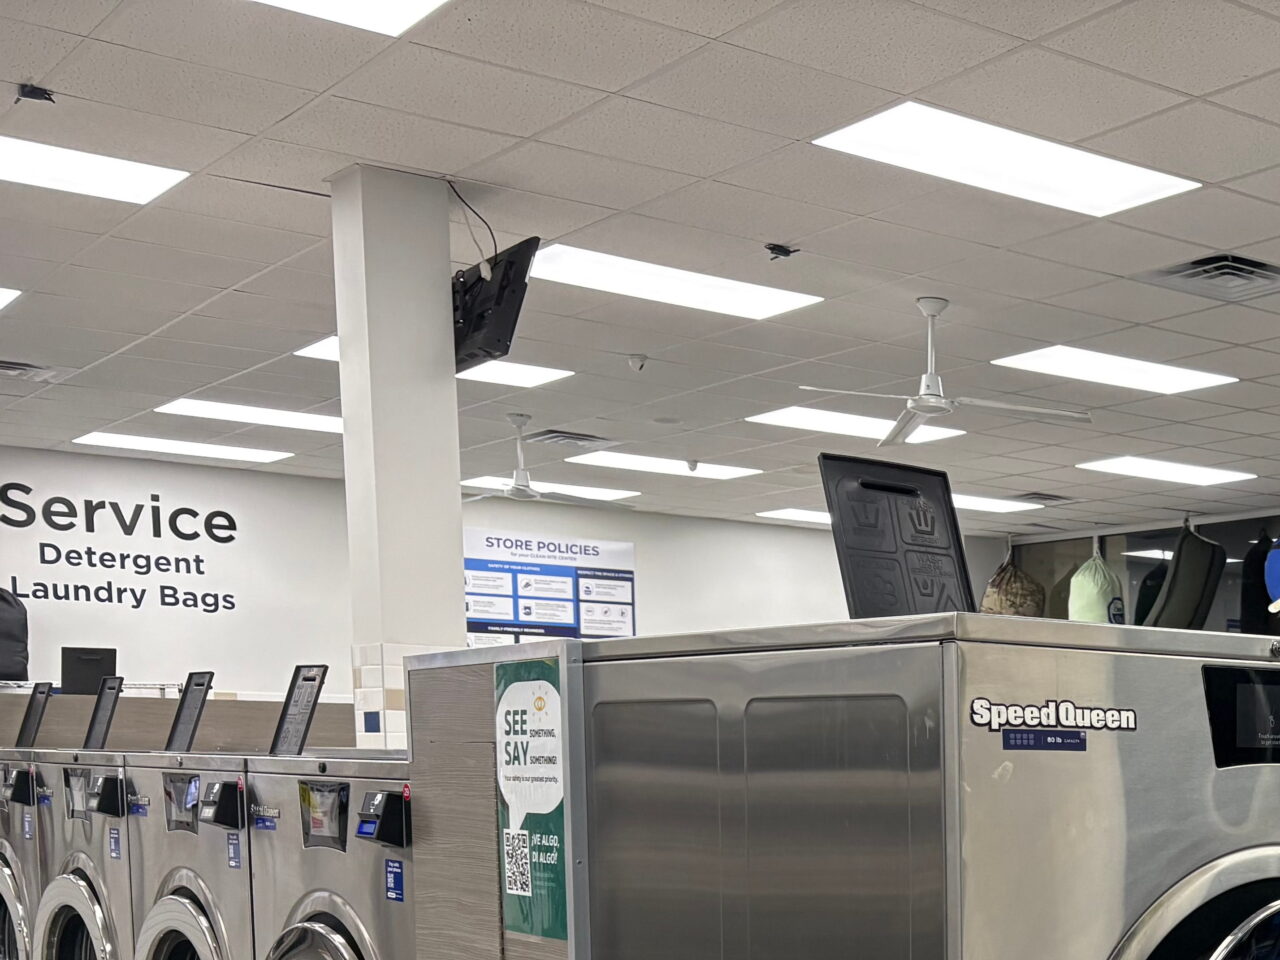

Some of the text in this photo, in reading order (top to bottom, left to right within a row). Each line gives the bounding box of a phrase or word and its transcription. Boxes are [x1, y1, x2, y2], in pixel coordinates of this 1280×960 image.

[0, 482, 237, 544] Service
[39, 542, 205, 575] Detergent
[486, 536, 600, 556] STORE POLICIES
[11, 576, 236, 613] Laundry Bags
[504, 709, 528, 736] SEE
[529, 728, 557, 739] SOMETHING,
[504, 740, 530, 766] SAY
[529, 755, 558, 765] SOMETHING!
[541, 834, 560, 848] ALGO,
